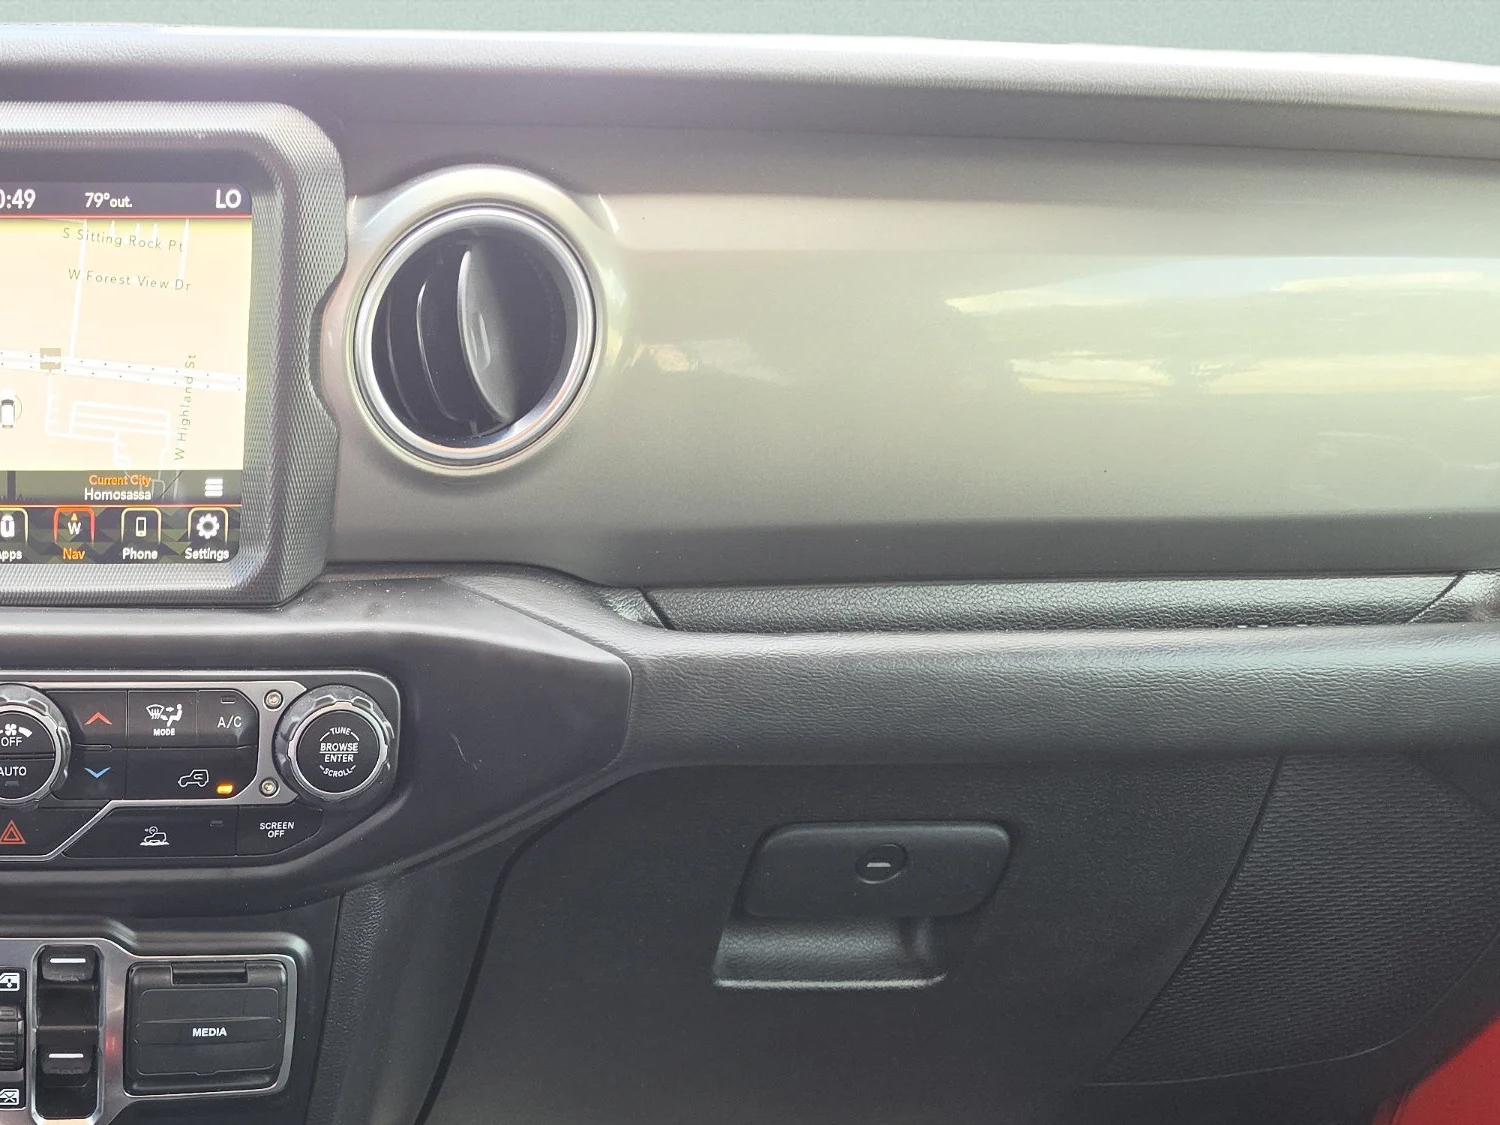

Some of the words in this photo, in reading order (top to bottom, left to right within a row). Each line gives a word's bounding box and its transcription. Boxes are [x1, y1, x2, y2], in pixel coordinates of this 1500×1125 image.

[215, 189, 242, 209] LO
[63, 228, 70, 239] S
[77, 229, 122, 248] Sitting
[128, 235, 162, 250] Rock
[68, 268, 81, 281] W
[86, 270, 132, 286] Forest
[138, 275, 169, 289] View
[175, 278, 191, 291] Dr
[185, 354, 196, 369] St
[177, 376, 194, 441] Highland
[174, 447, 185, 460] W
[89, 475, 128, 485] Current
[130, 475, 152, 488] City
[84, 488, 151, 500] Homosassa
[63, 548, 85, 560] Nav
[122, 548, 158, 560] Phone
[185, 549, 229, 563] Settings
[217, 715, 242, 728] A/C
[153, 728, 176, 736] MODE
[330, 727, 351, 736] TUNE
[1, 736, 22, 747] OFF
[320, 743, 358, 752] BROWSE
[324, 754, 354, 763] ENTER
[323, 767, 353, 777] SCROLL
[260, 821, 295, 830] SCREEN
[267, 830, 285, 838] OFF
[192, 1027, 227, 1037] MEDIA
